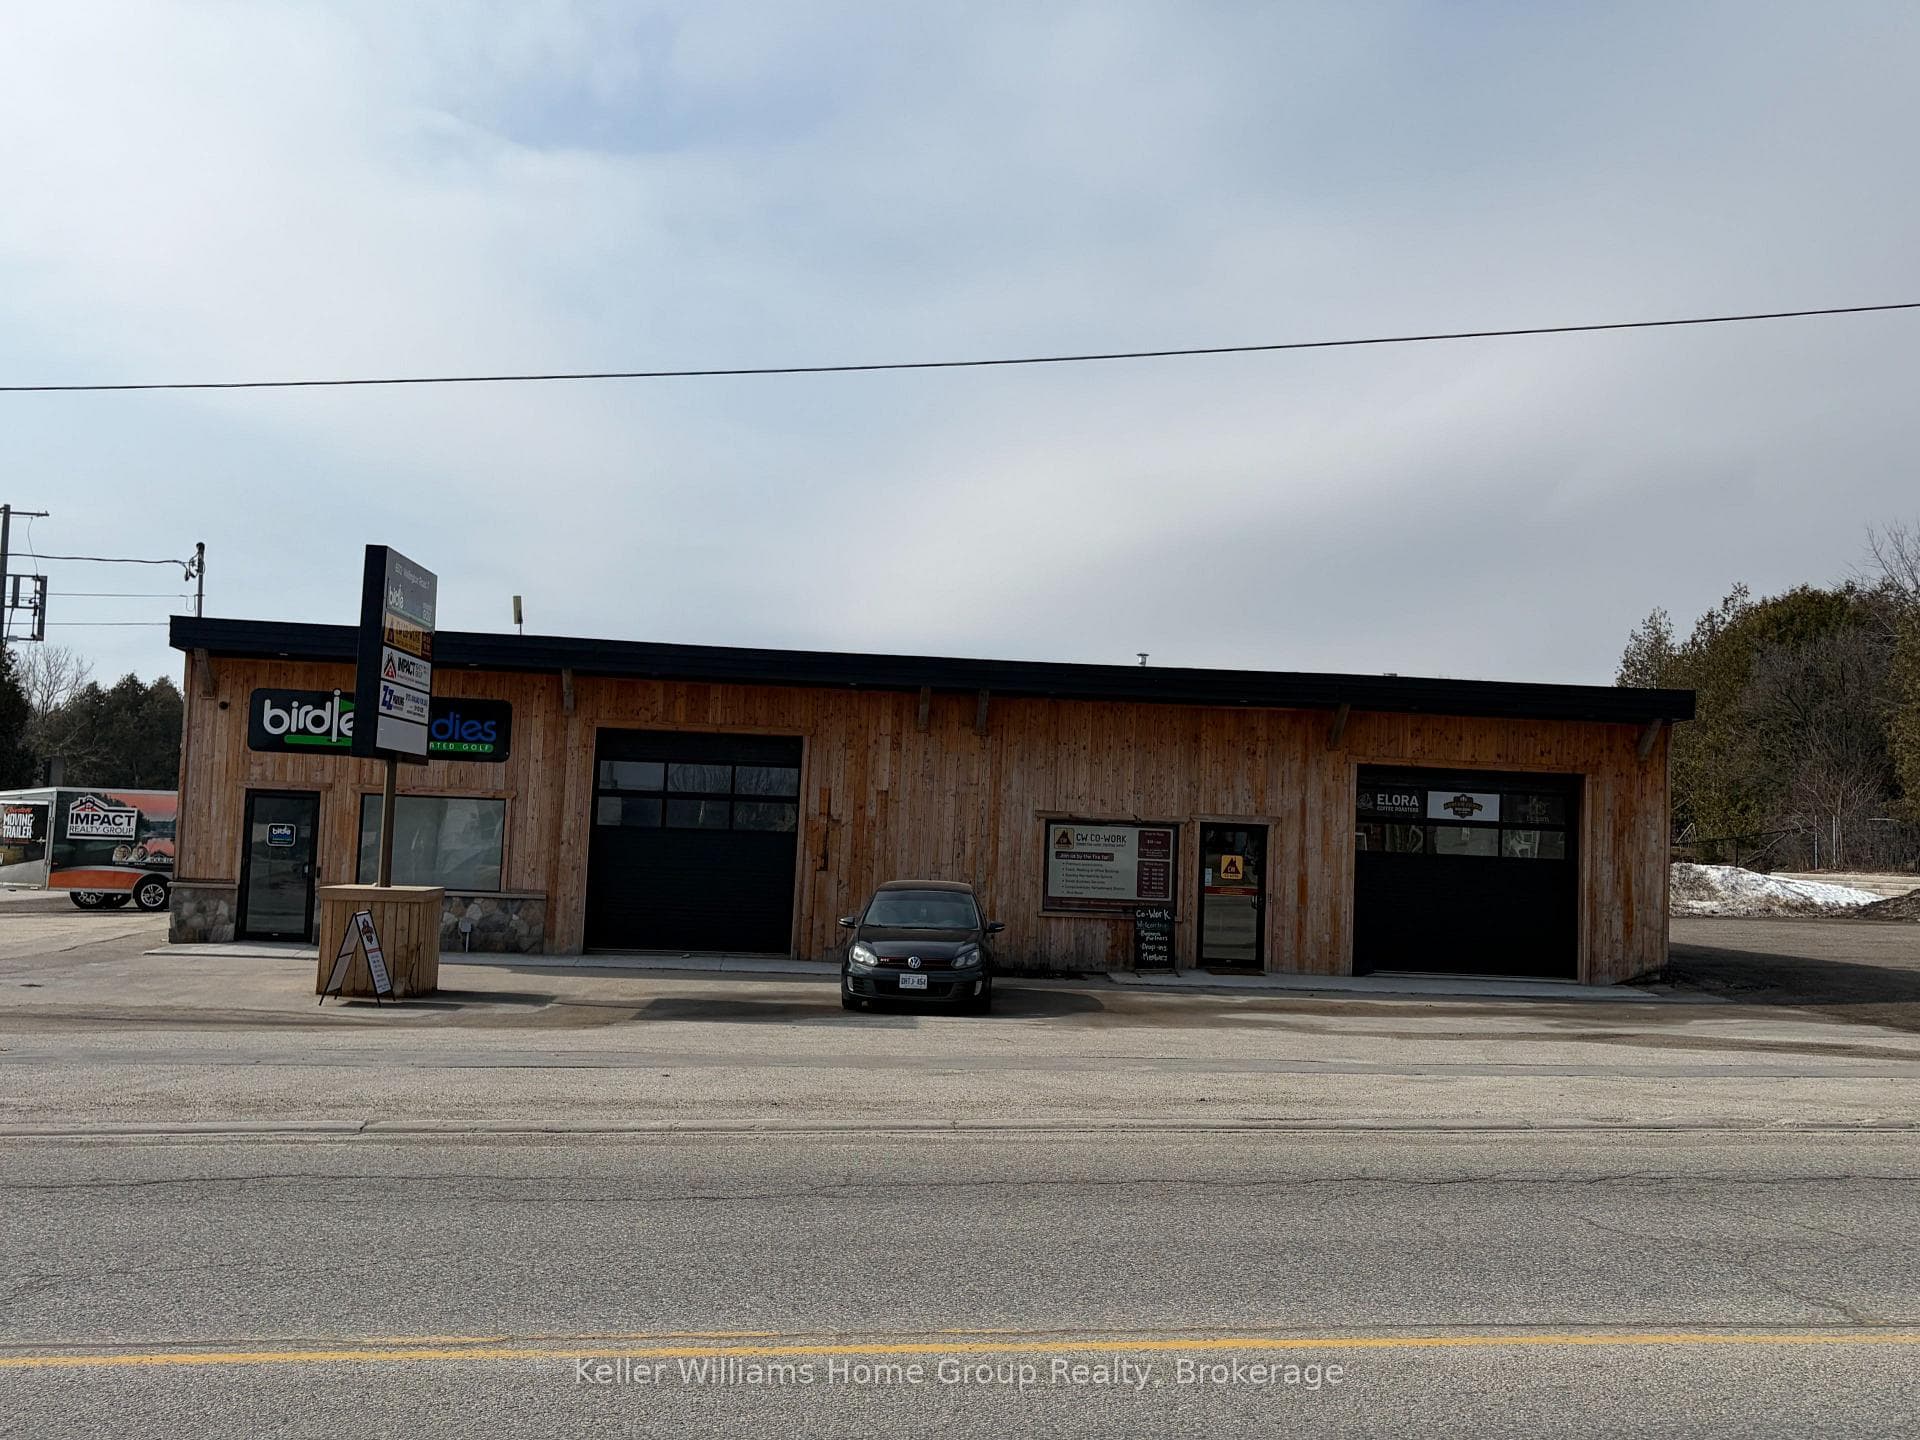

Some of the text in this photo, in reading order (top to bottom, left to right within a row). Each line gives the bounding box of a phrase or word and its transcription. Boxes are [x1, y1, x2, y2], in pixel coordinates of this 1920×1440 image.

[431, 711, 497, 743] dies
[462, 743, 490, 752] GOLF
[1377, 793, 1419, 807] ELORA
[3, 813, 33, 826] MOVING
[71, 813, 135, 827] IMPACT
[3, 826, 32, 839] TRAILER
[70, 826, 134, 836] REALTY GROUP
[1076, 833, 1127, 844] CW CO-WORK
